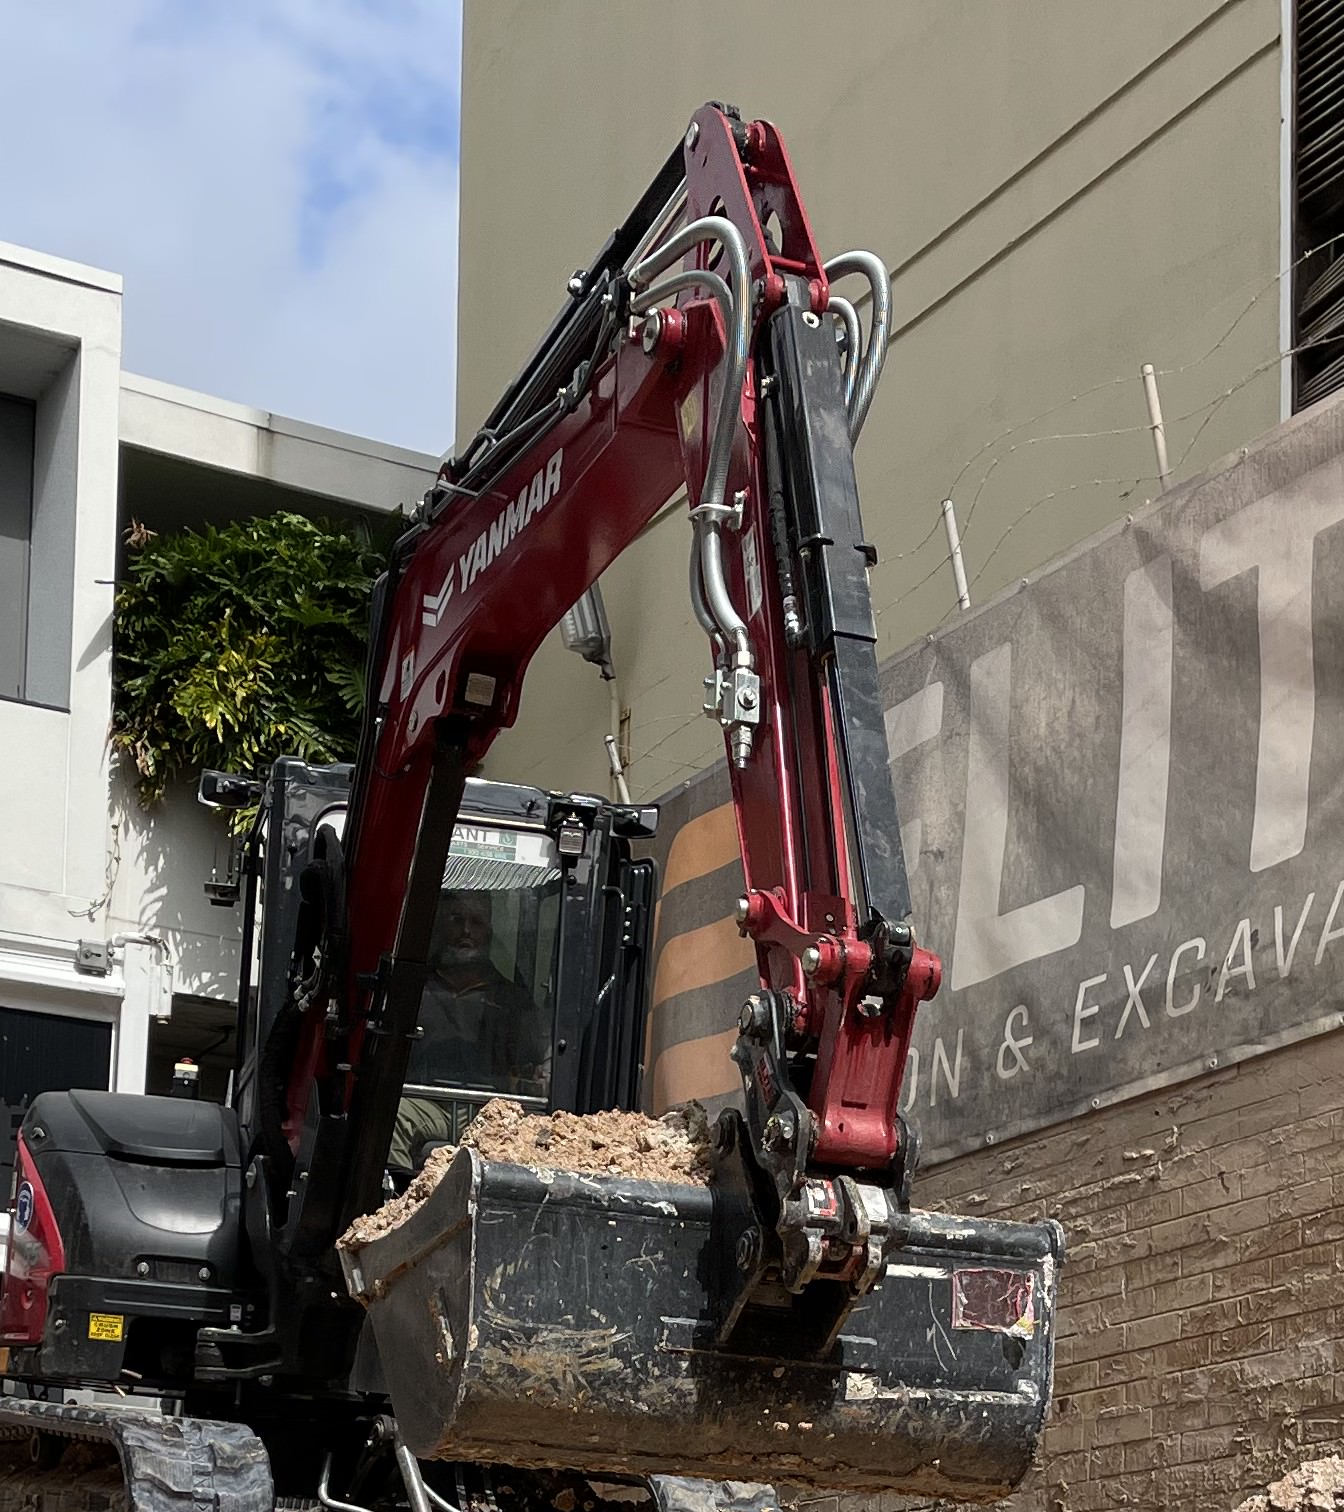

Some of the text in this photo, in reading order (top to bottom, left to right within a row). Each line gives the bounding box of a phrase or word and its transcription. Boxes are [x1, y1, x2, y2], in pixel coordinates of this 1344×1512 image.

[459, 447, 564, 595] YANMAR
[452, 826, 488, 842] ANT
[996, 1004, 1034, 1080] &
